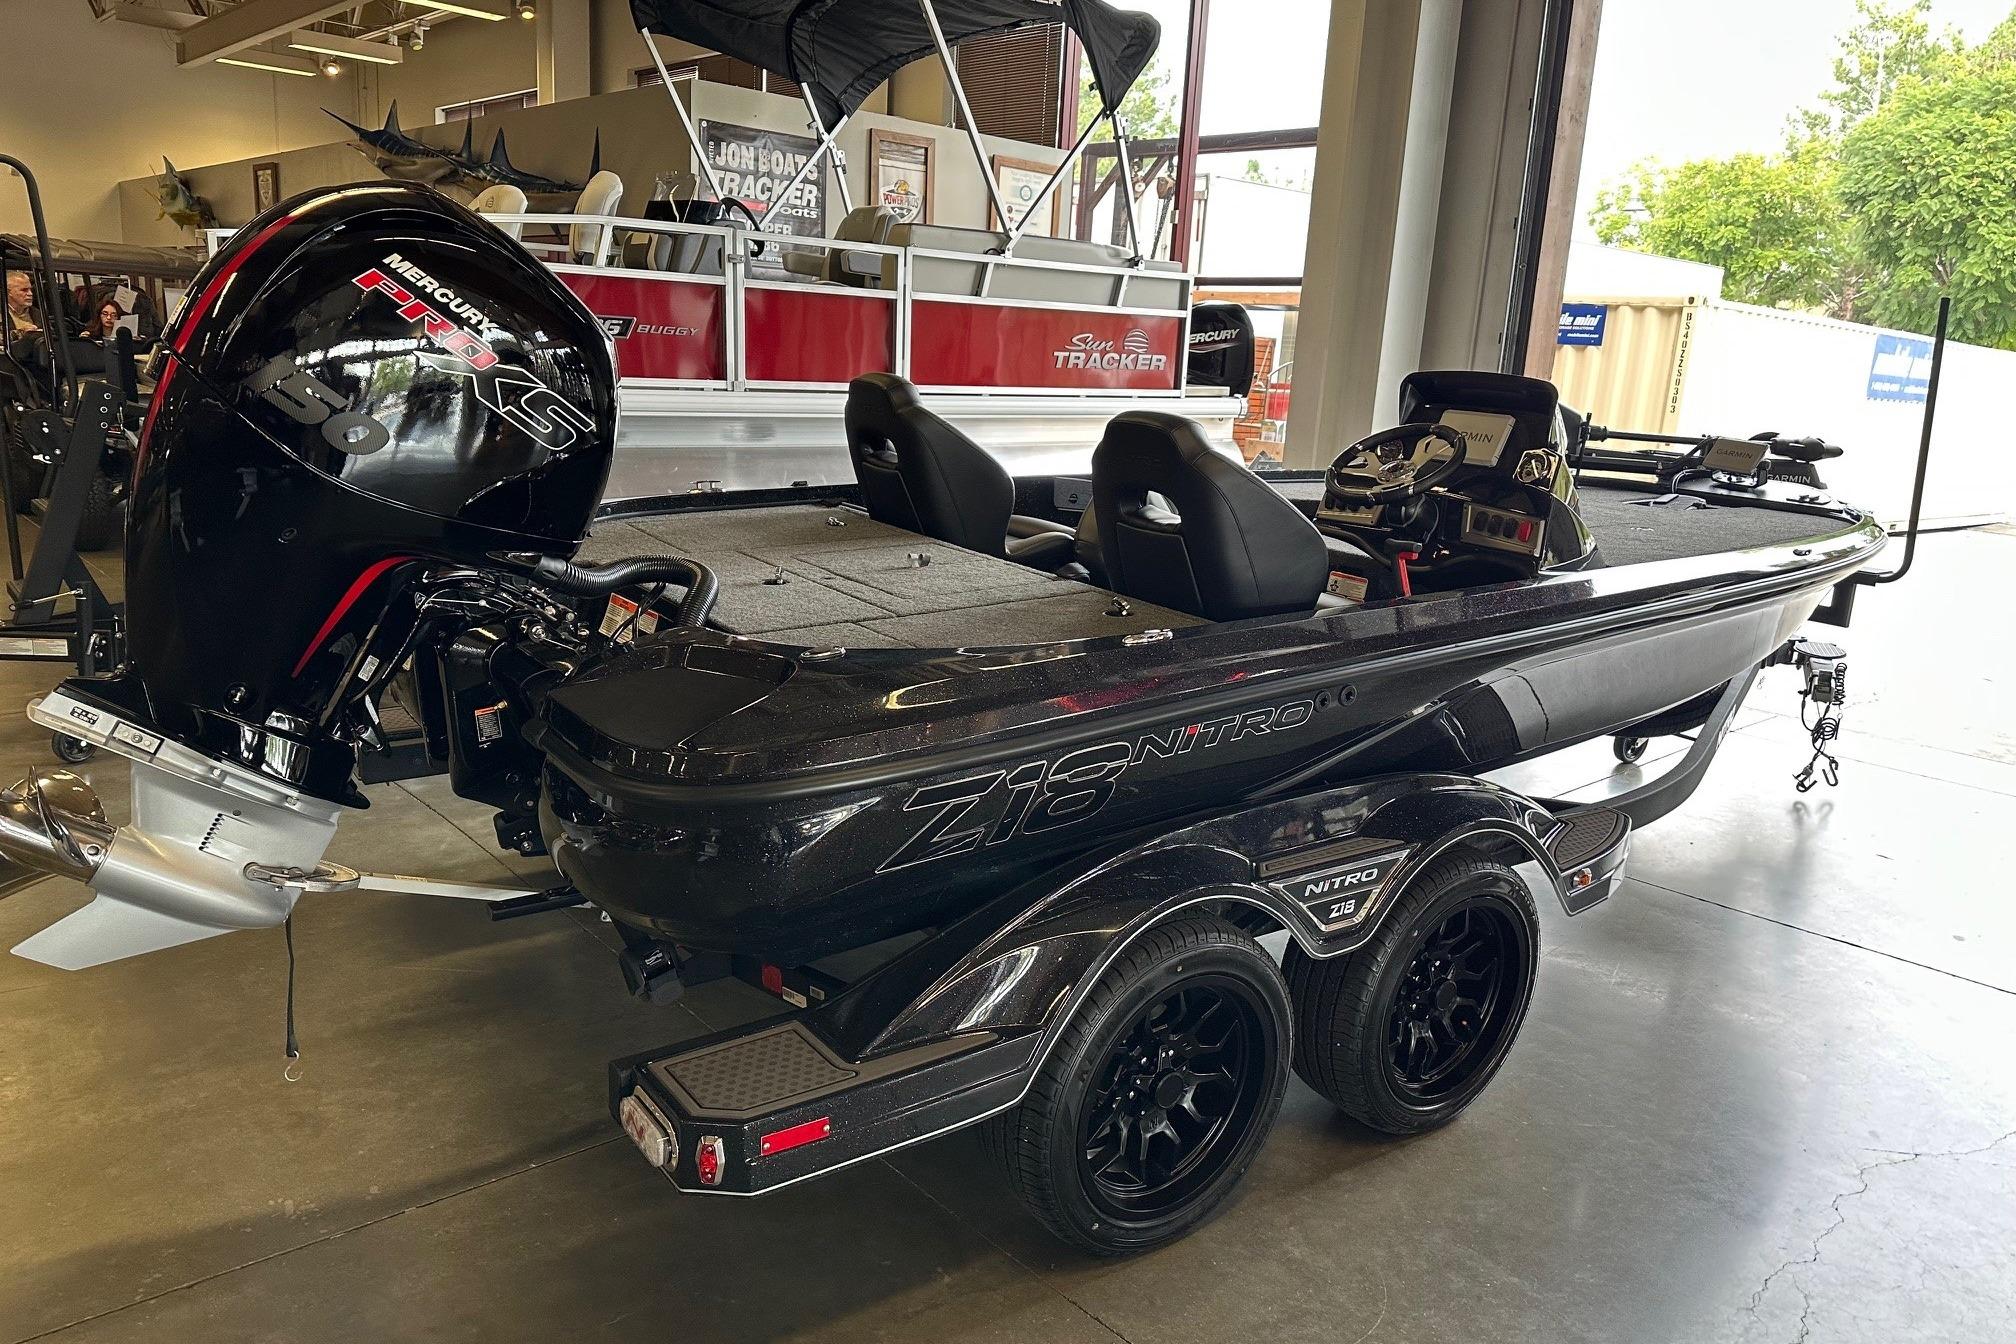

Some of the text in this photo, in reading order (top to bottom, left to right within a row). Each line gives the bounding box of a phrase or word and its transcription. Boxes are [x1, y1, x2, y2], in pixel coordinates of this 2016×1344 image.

[715, 141, 755, 171] JON
[382, 252, 500, 331] MERCURY
[351, 268, 499, 371] PRO
[636, 323, 700, 337] BUGGY
[1189, 328, 1240, 344] ERCURY
[1065, 333, 1114, 351] Sun
[1053, 351, 1167, 371] TRACKER
[413, 325, 597, 450] XS
[1460, 431, 1494, 443] RMIN
[1716, 448, 1753, 460] GARMIN
[1766, 474, 1811, 484] GARMIN
[875, 699, 1314, 874] Z18 NITRO
[1304, 868, 1378, 897] NITRO
[1328, 899, 1356, 919] Z18
